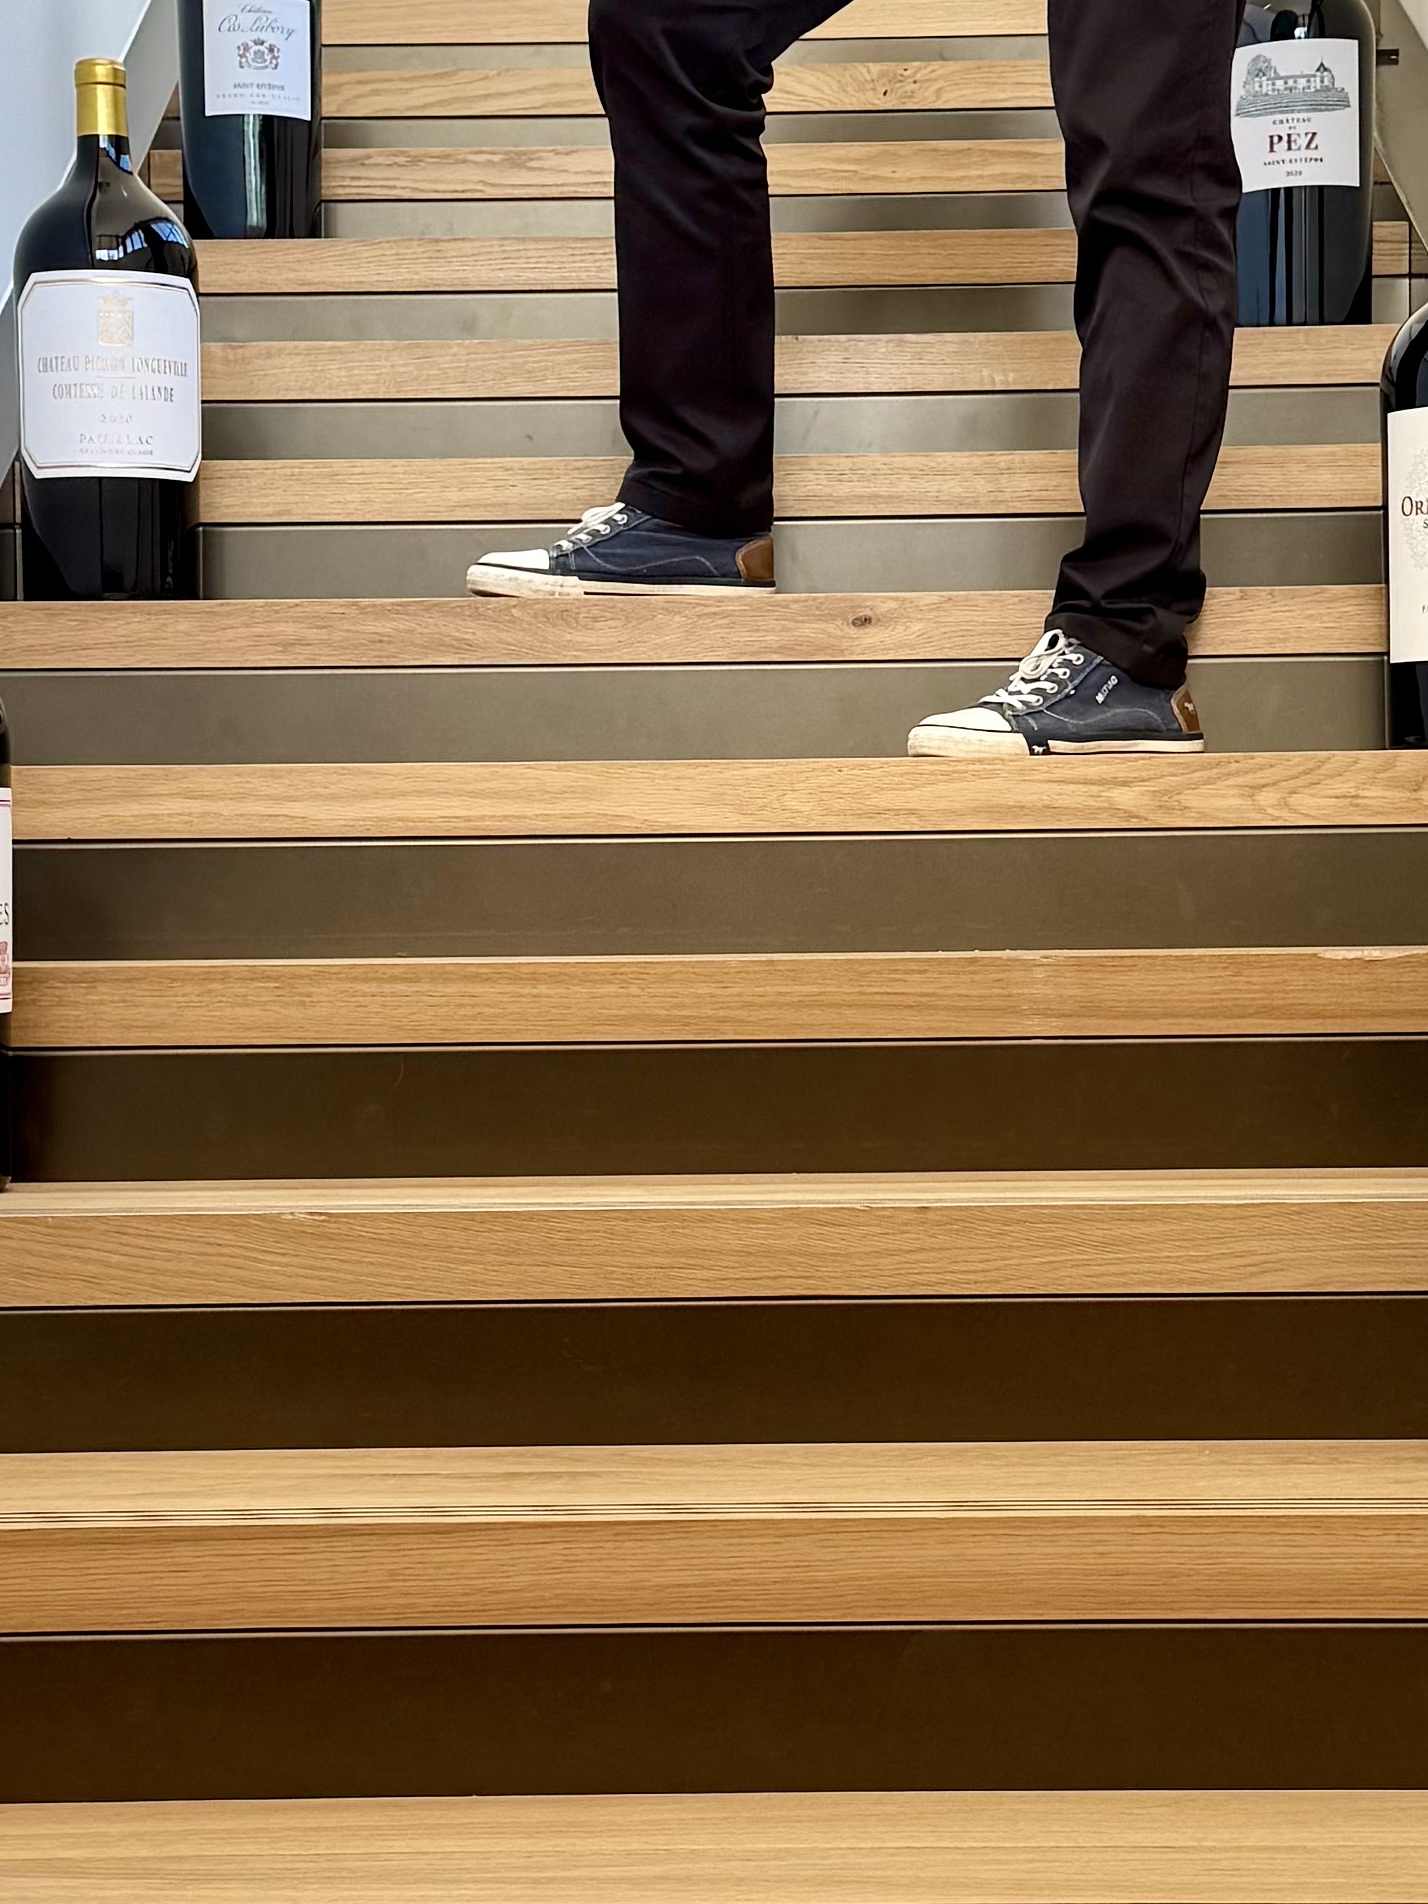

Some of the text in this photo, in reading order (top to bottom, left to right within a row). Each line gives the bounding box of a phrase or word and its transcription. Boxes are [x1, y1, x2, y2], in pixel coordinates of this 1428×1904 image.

[1268, 132, 1318, 153] PEZ
[53, 383, 104, 400] COMTESSE
[132, 385, 174, 402] LALANDE
